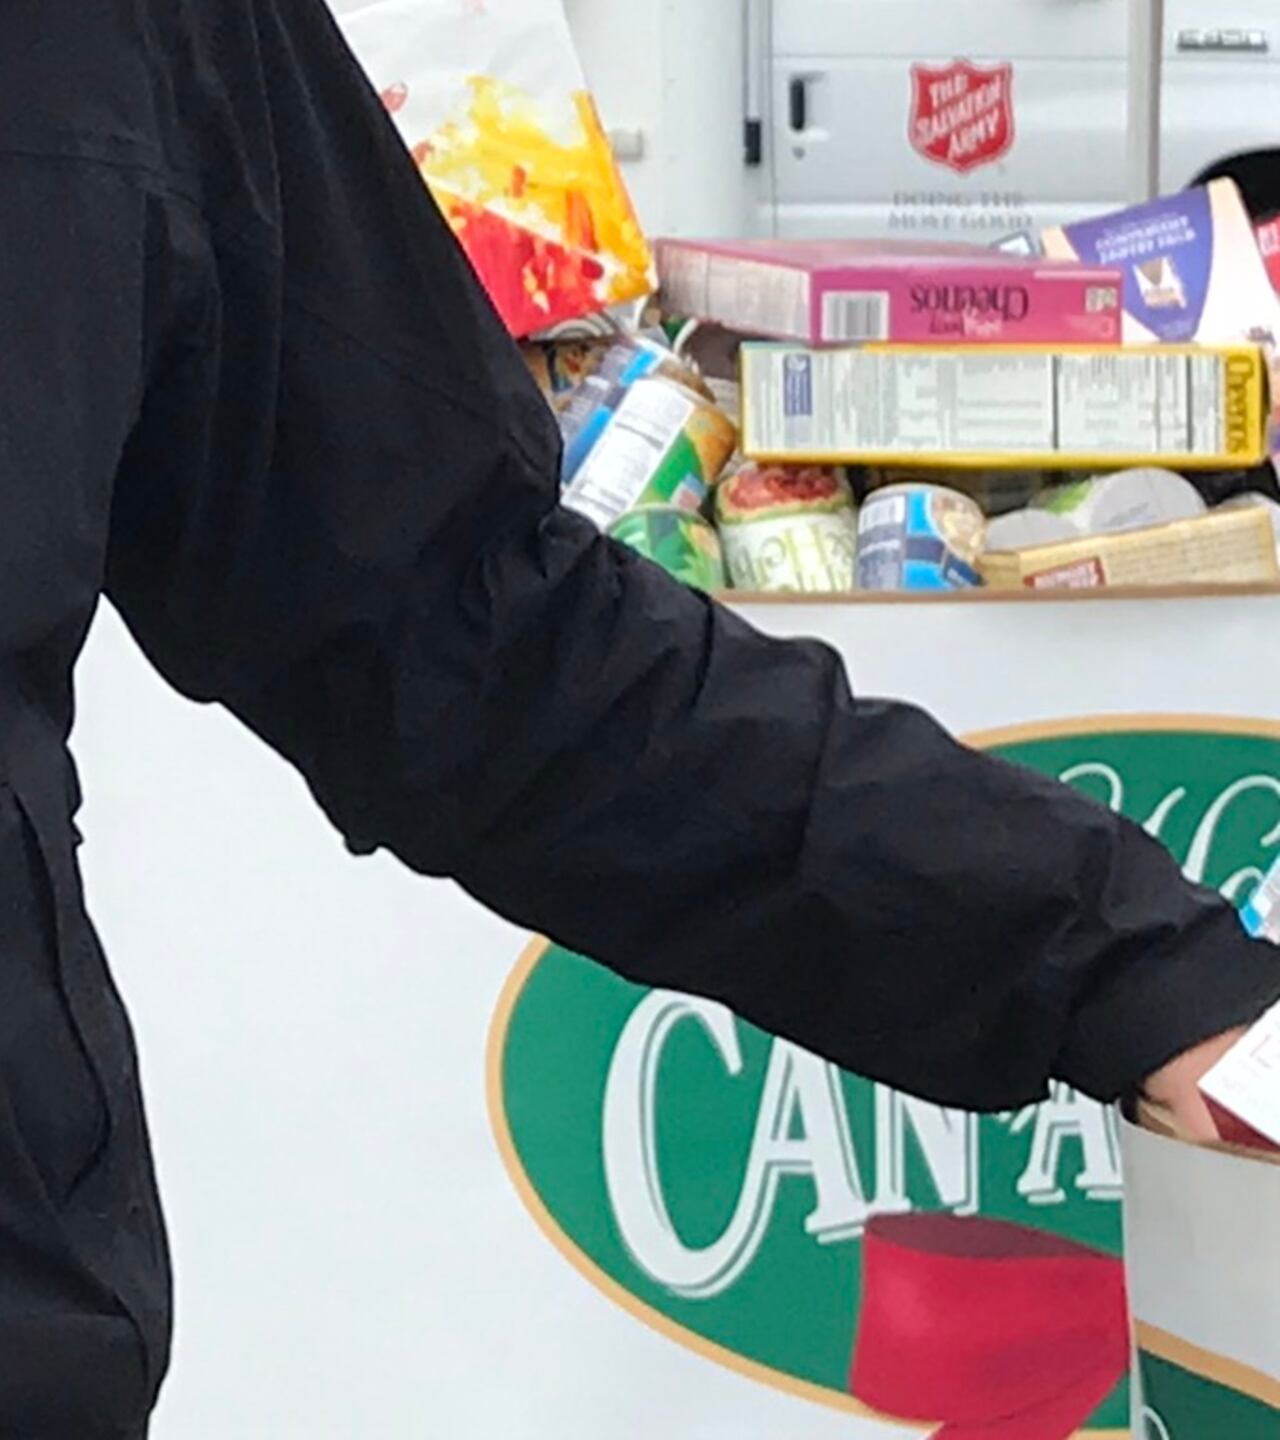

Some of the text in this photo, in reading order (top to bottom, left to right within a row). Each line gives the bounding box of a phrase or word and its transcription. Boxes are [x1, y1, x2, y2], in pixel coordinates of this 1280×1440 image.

[915, 73, 1001, 146] SALVATION
[929, 73, 969, 108] THE
[947, 106, 1000, 162] ARMY
